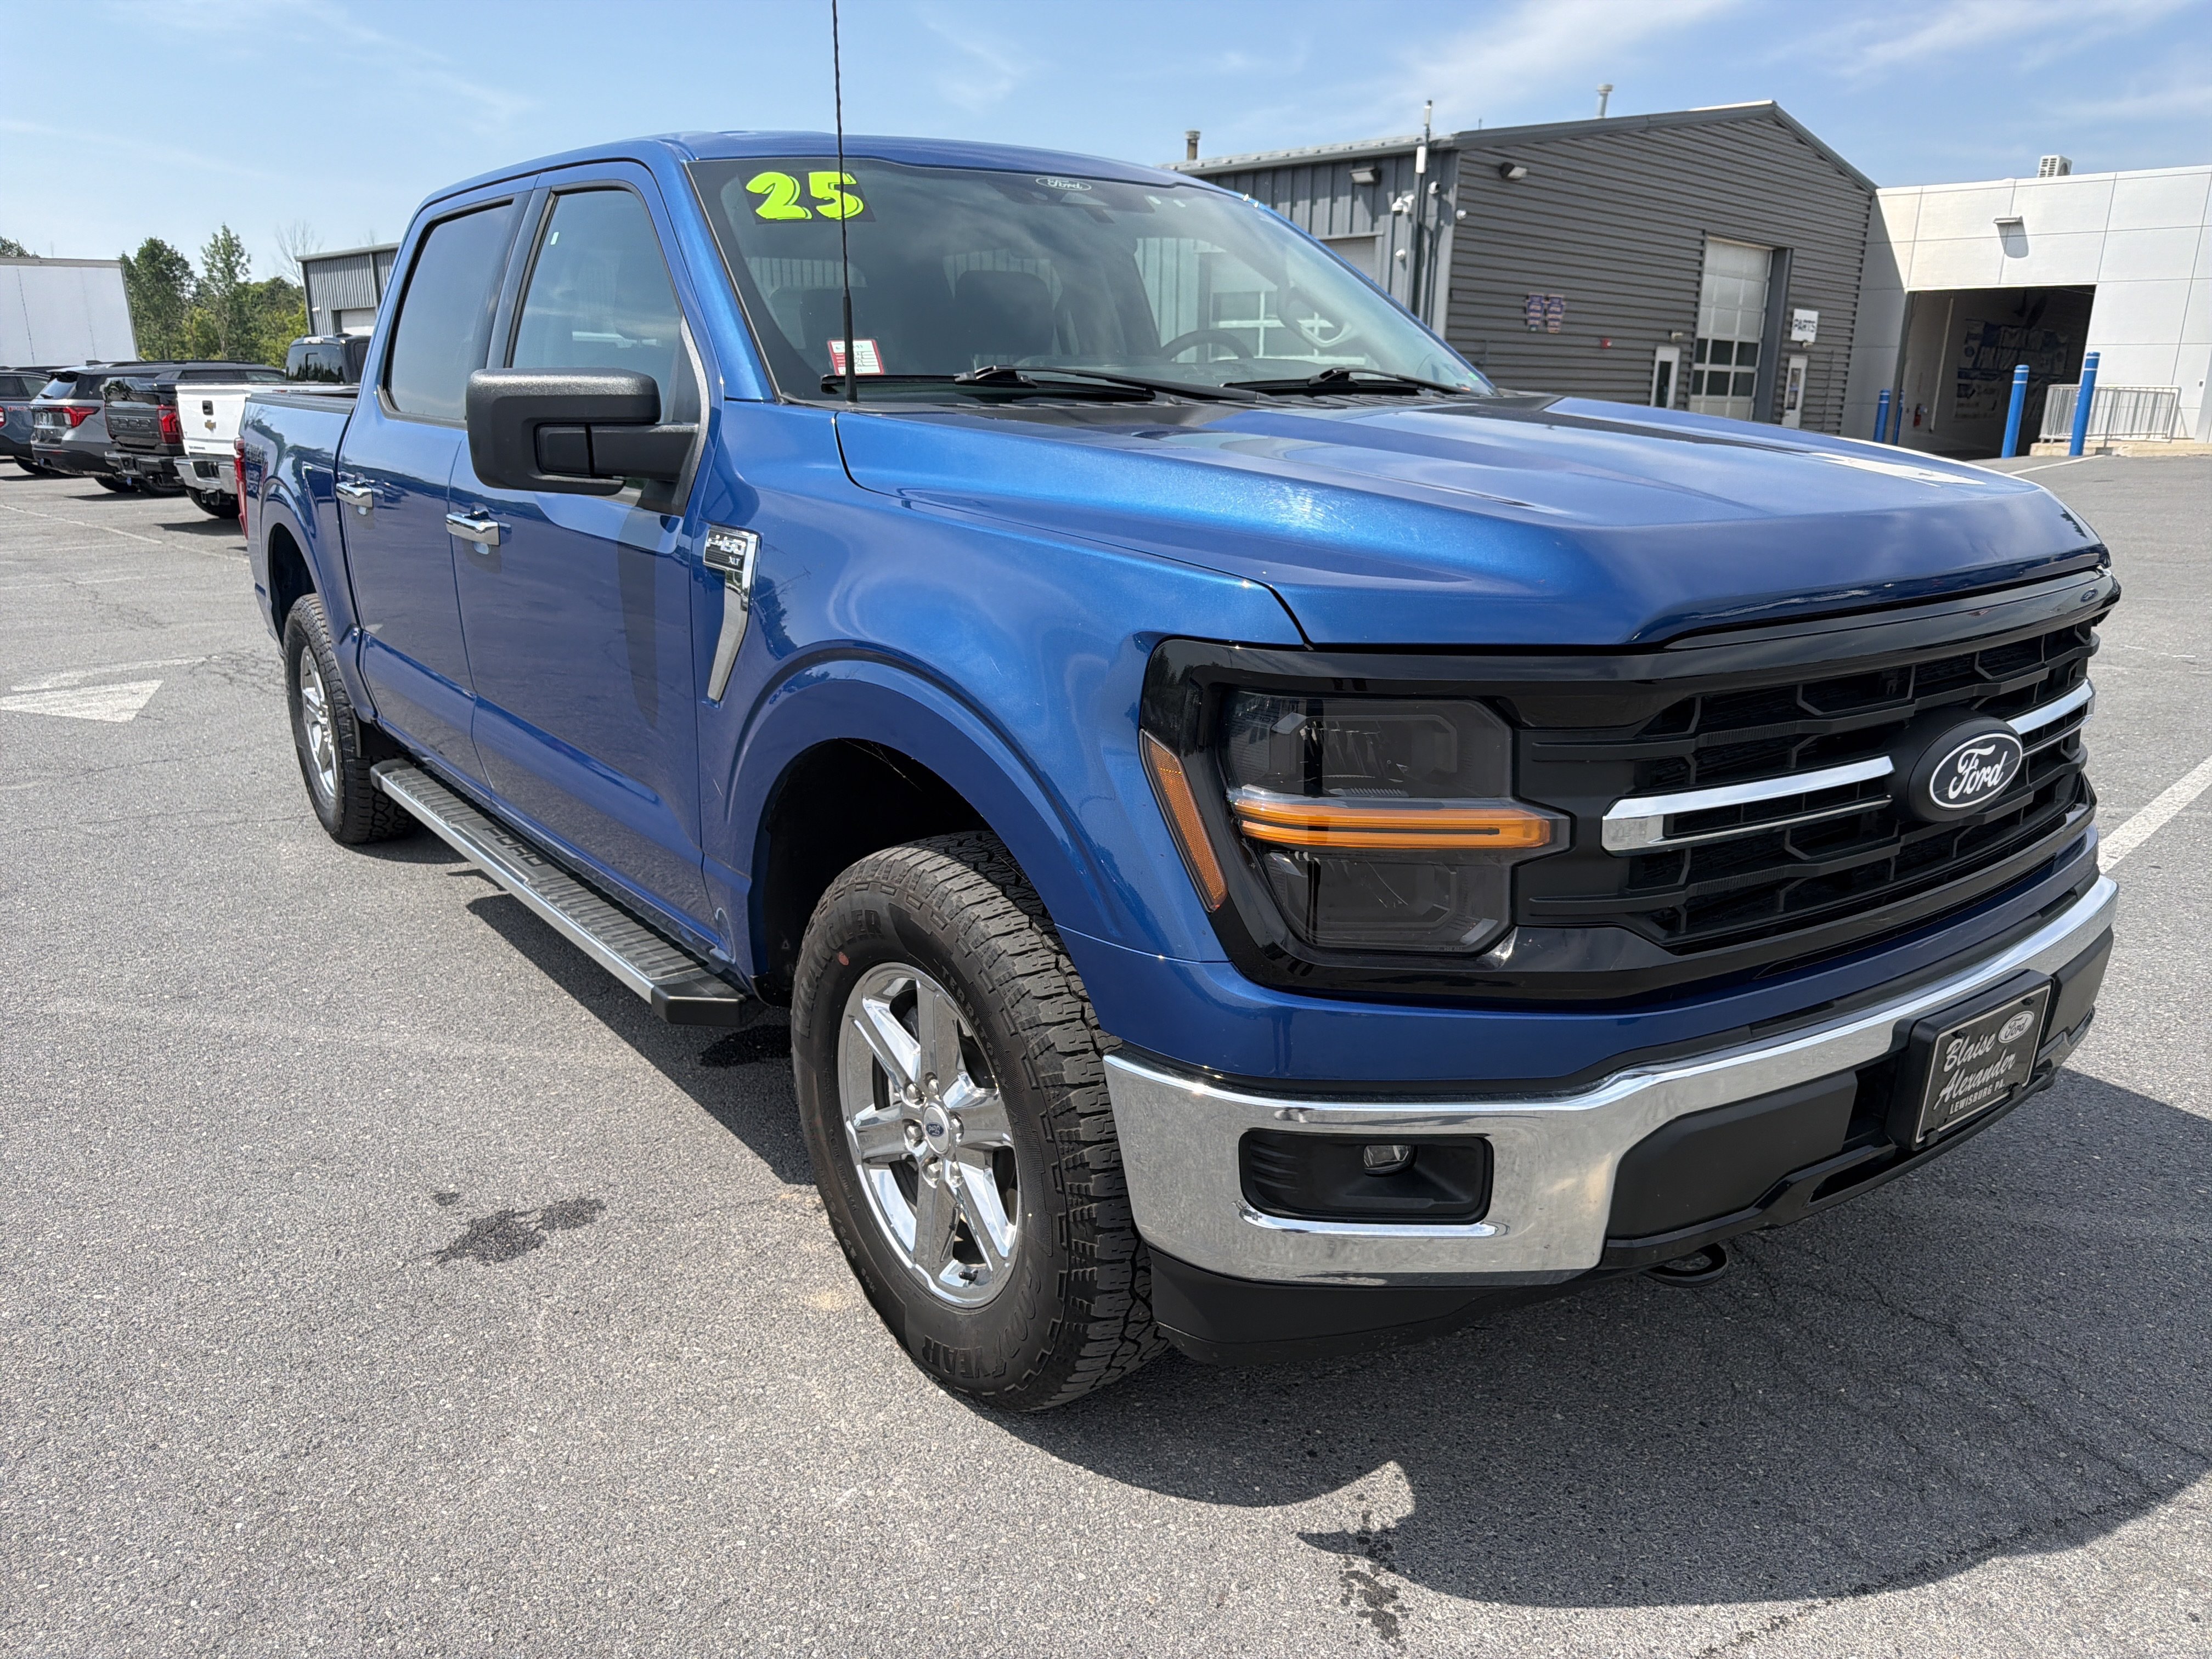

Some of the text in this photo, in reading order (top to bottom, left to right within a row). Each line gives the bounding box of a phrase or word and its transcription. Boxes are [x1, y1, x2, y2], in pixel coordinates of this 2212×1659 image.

[746, 172, 865, 220] 25
[1047, 179, 1082, 189] Ford
[729, 556, 741, 566] XLT
[1949, 744, 2008, 799] Ford
[795, 909, 882, 1037] WRANGLER
[2005, 1016, 2028, 1039] Ford
[1944, 1033, 1996, 1073] Blaise
[1933, 1048, 2016, 1110] Alexander
[1949, 1078, 2006, 1115] LEWISBURG PA.
